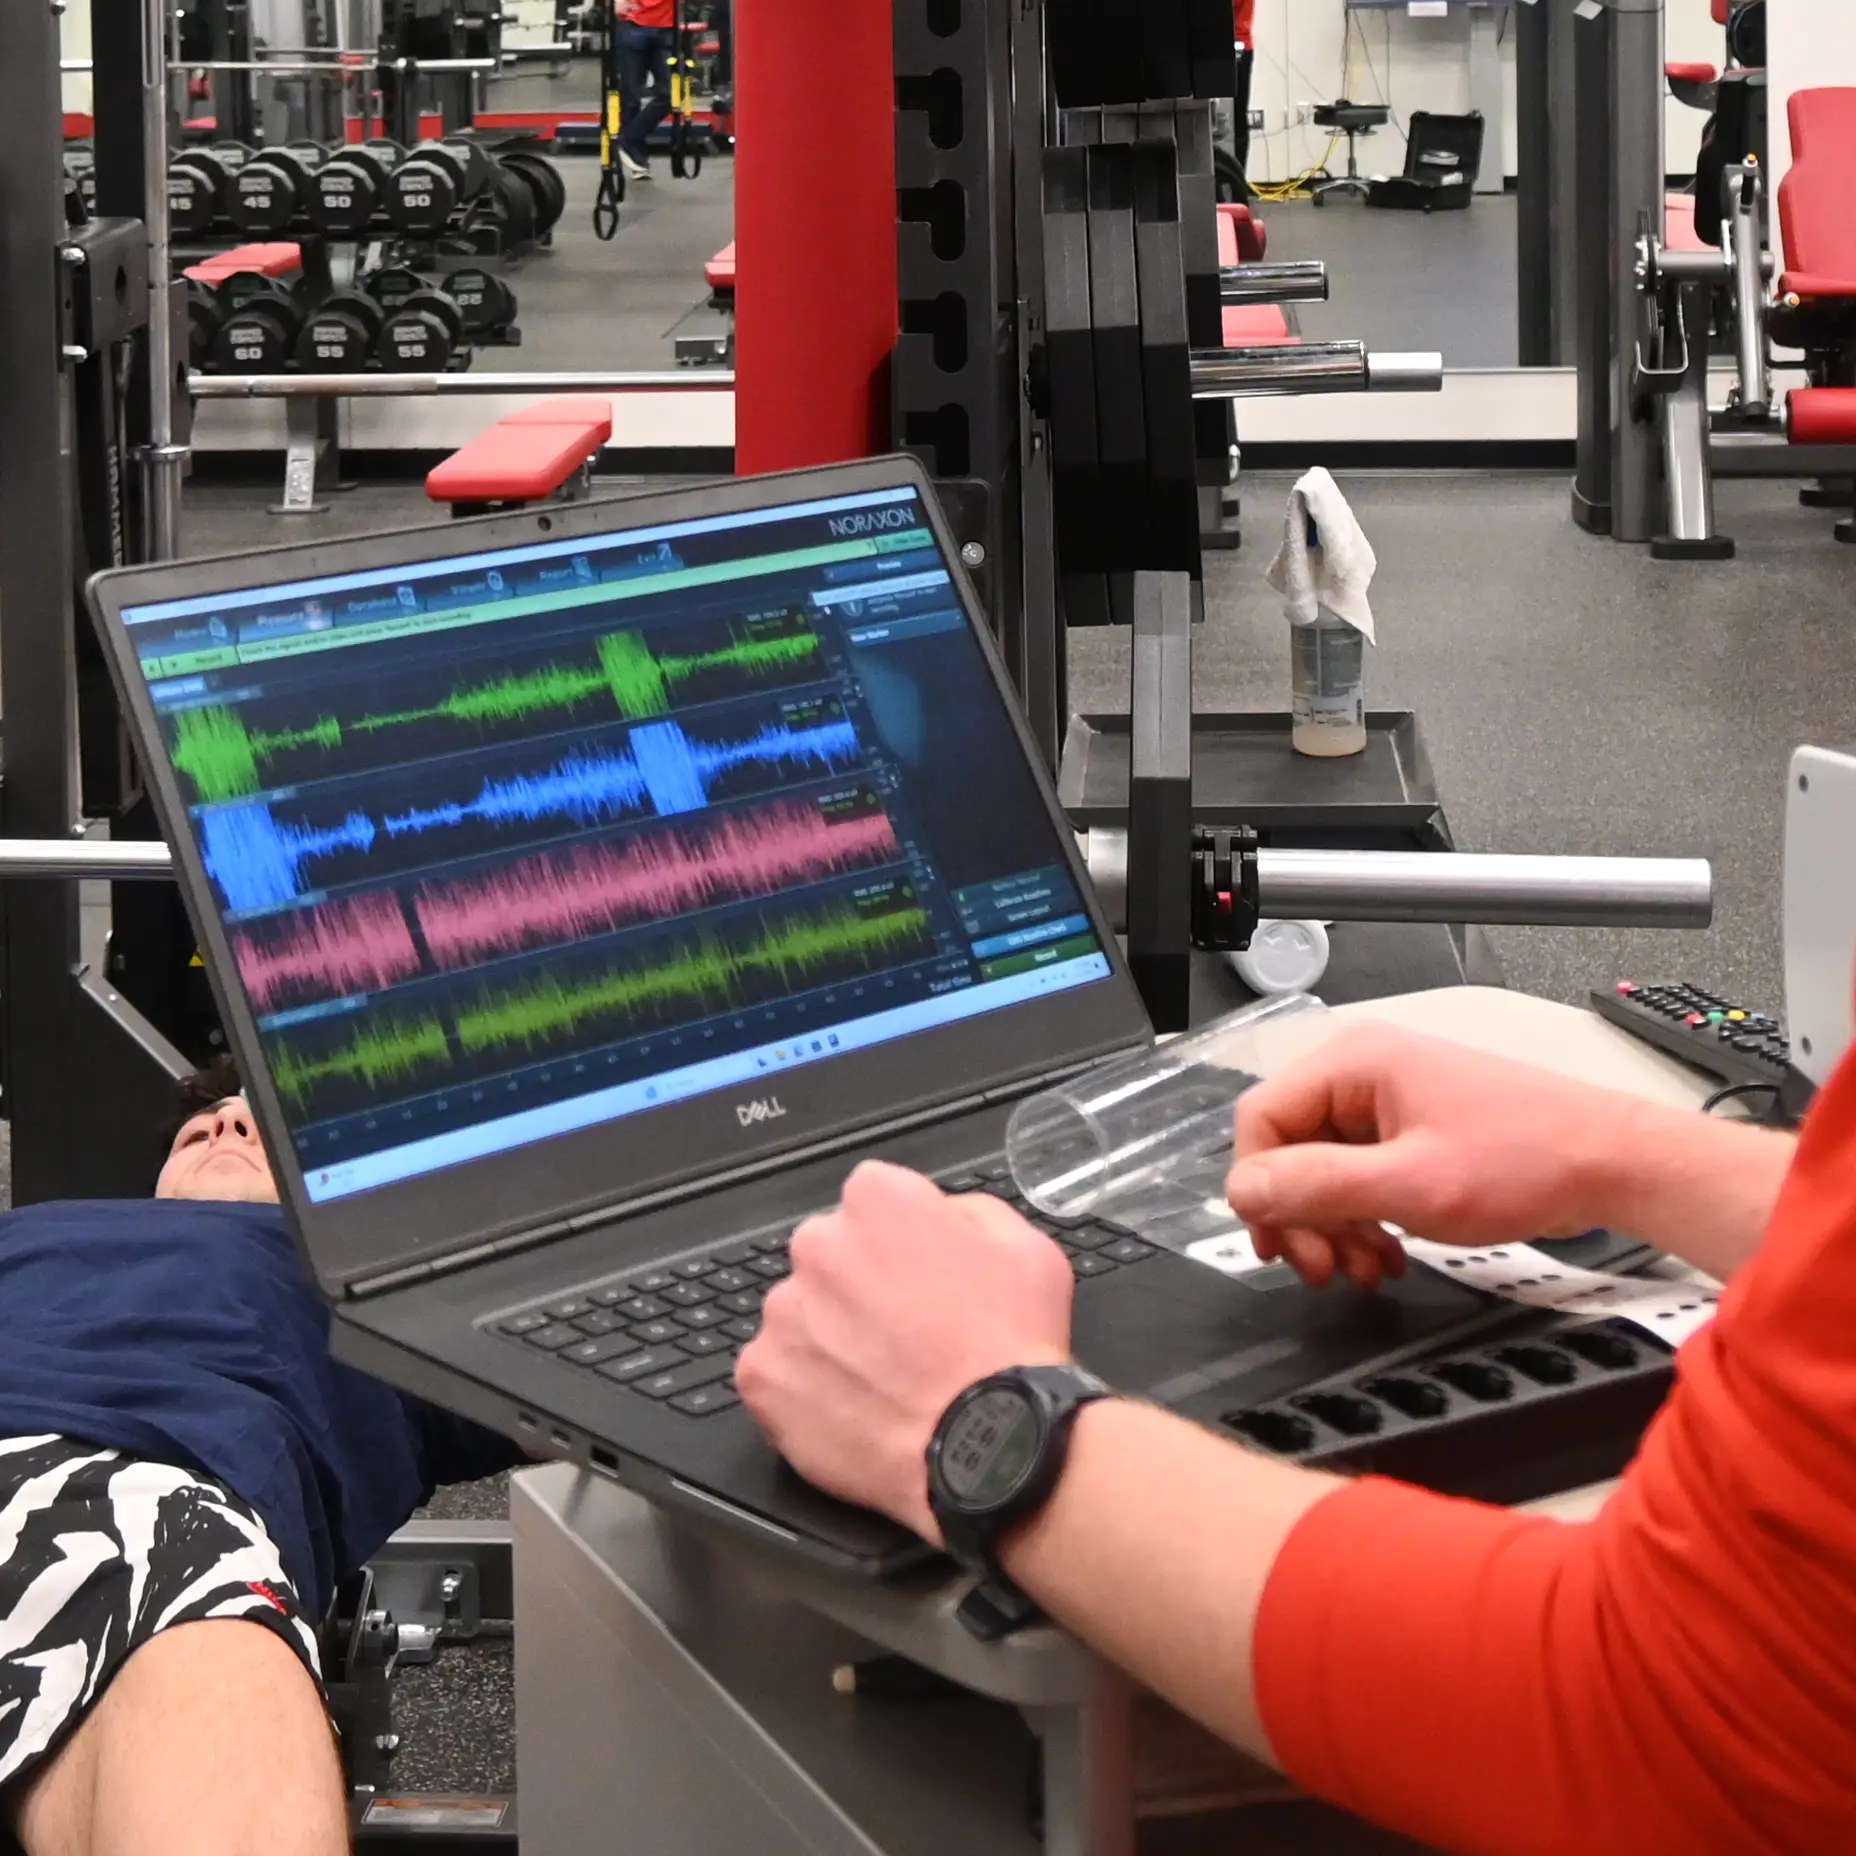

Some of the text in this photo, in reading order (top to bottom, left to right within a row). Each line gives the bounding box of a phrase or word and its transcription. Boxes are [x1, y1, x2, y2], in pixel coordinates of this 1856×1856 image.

[242, 195, 272, 209] 45
[322, 195, 352, 209] 50
[403, 194, 431, 208] 50
[316, 345, 345, 359] 55
[397, 344, 426, 358] 55
[735, 1095, 787, 1126] DELL
